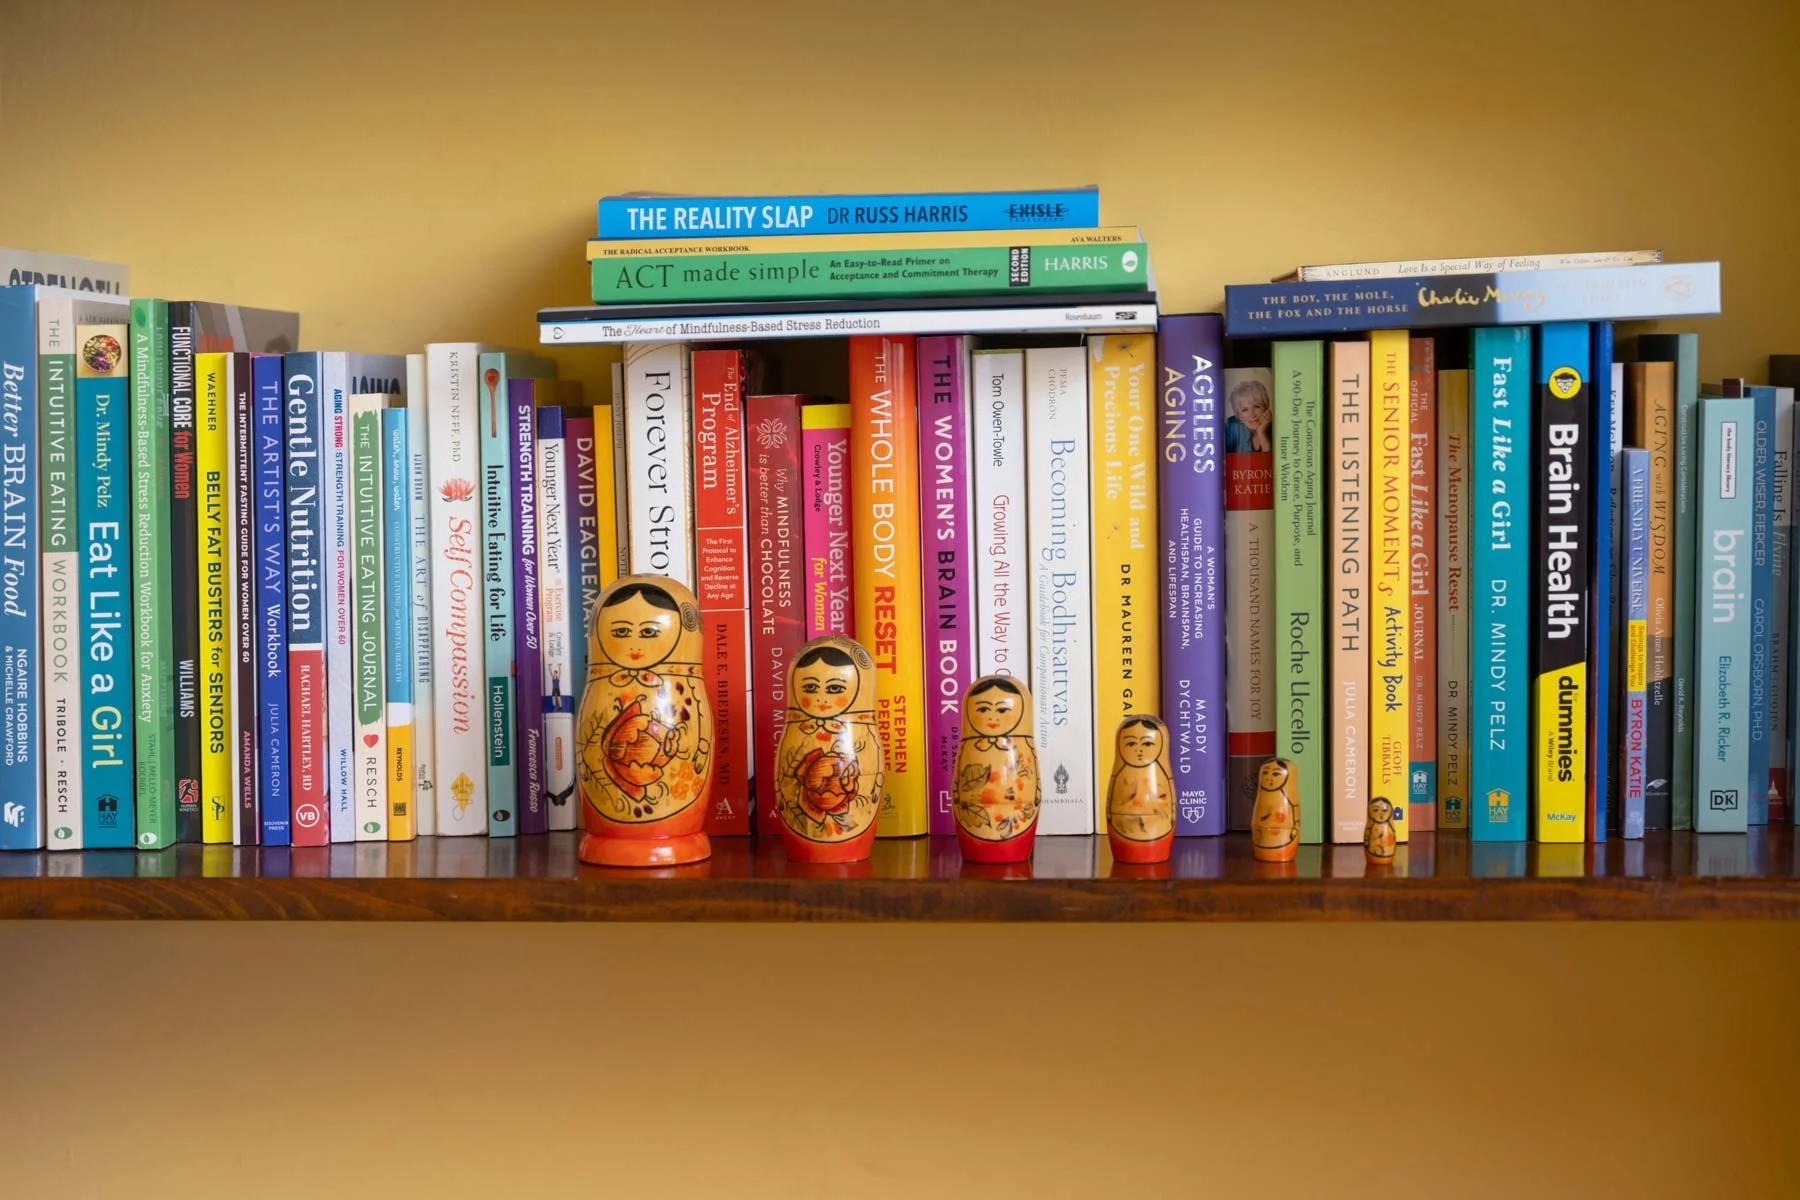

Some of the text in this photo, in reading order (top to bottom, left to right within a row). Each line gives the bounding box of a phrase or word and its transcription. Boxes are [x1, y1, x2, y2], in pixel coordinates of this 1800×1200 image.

[627, 206, 812, 230] THE REALITY SLAP
[828, 205, 967, 224] DR RUSS HARRIS
[616, 259, 819, 288] ACT made simple
[844, 258, 902, 269] Easy-to-Read
[882, 268, 998, 279] and Commitment Therapy
[1045, 256, 1107, 271] HARRIS
[1262, 296, 1286, 304] THE
[1324, 293, 1348, 301] THE
[1248, 304, 1407, 319] THE FOX AND THE HORSE
[208, 373, 216, 430] WAEHNER
[992, 373, 1004, 466] Tom Owen-Towle
[1384, 383, 1399, 468] SENIOR
[94, 395, 111, 508] Dr. Mindy Pelz
[698, 394, 720, 489] Program
[725, 384, 740, 514] End Alzheimer's
[1492, 357, 1512, 550] Fast Like a Girl
[4, 362, 26, 617] Better BRAIN Food
[48, 319, 67, 682] THE INTUITIVE EATING WORKBOOK
[289, 374, 317, 631] Gentle Nutrition
[823, 437, 849, 584] Younger Next
[868, 351, 899, 677] THE WHOLE BODY RESET
[1342, 374, 1359, 651] THE LISTENING PATH
[137, 334, 153, 722] A Mindfulness-Based Stress Reduction Workbook for Anxiety
[759, 454, 774, 634] is better than CHOCOLATE
[774, 468, 791, 607] Why MINDFULNESS
[934, 355, 958, 714] THE WOMEN'S BRAIN BOOK
[1194, 518, 1202, 551] GUIDE
[1194, 555, 1202, 569] TO
[1548, 424, 1580, 638] Brain Health
[1755, 514, 1765, 566] FIERCER
[811, 558, 827, 630] for Women
[1042, 440, 1076, 725] Becoming Bodhisattvas
[1207, 557, 1215, 609] WOMAN'S
[1713, 530, 1744, 622] brain
[90, 522, 123, 768] Eat Like a Girl
[206, 472, 224, 754] BELLY FAT BUSTERS for SENIORS
[446, 516, 475, 734] Self Compassion
[717, 624, 727, 659] DALE
[1753, 599, 1764, 641] CAROL
[5, 656, 13, 704] MICHELLE
[180, 660, 194, 717] WILLIAMS
[301, 665, 311, 717] RACHAEL
[1291, 612, 1310, 754] Roche Uccello
[1378, 607, 1403, 712] Activity Book
[1719, 656, 1731, 709] Elizabeth
[5, 707, 13, 765] CRAWFORD
[17, 649, 27, 762] NGAIRE HOBBINS
[57, 698, 66, 752] TRIBOLE
[493, 685, 505, 757] Hollenstein
[1180, 680, 1190, 773] DYCHTWALD
[1196, 699, 1206, 753] MADDY
[528, 729, 540, 812] Francesca Russo
[720, 764, 729, 785] MD
[1382, 737, 1390, 784] TIBBALLS
[1393, 741, 1401, 776] GEOFF
[1630, 700, 1642, 798] BYRON KATIE
[1718, 728, 1730, 762] Ricker
[58, 771, 67, 812] RESCH
[303, 775, 311, 790] RD
[1547, 813, 1576, 821] McKay
